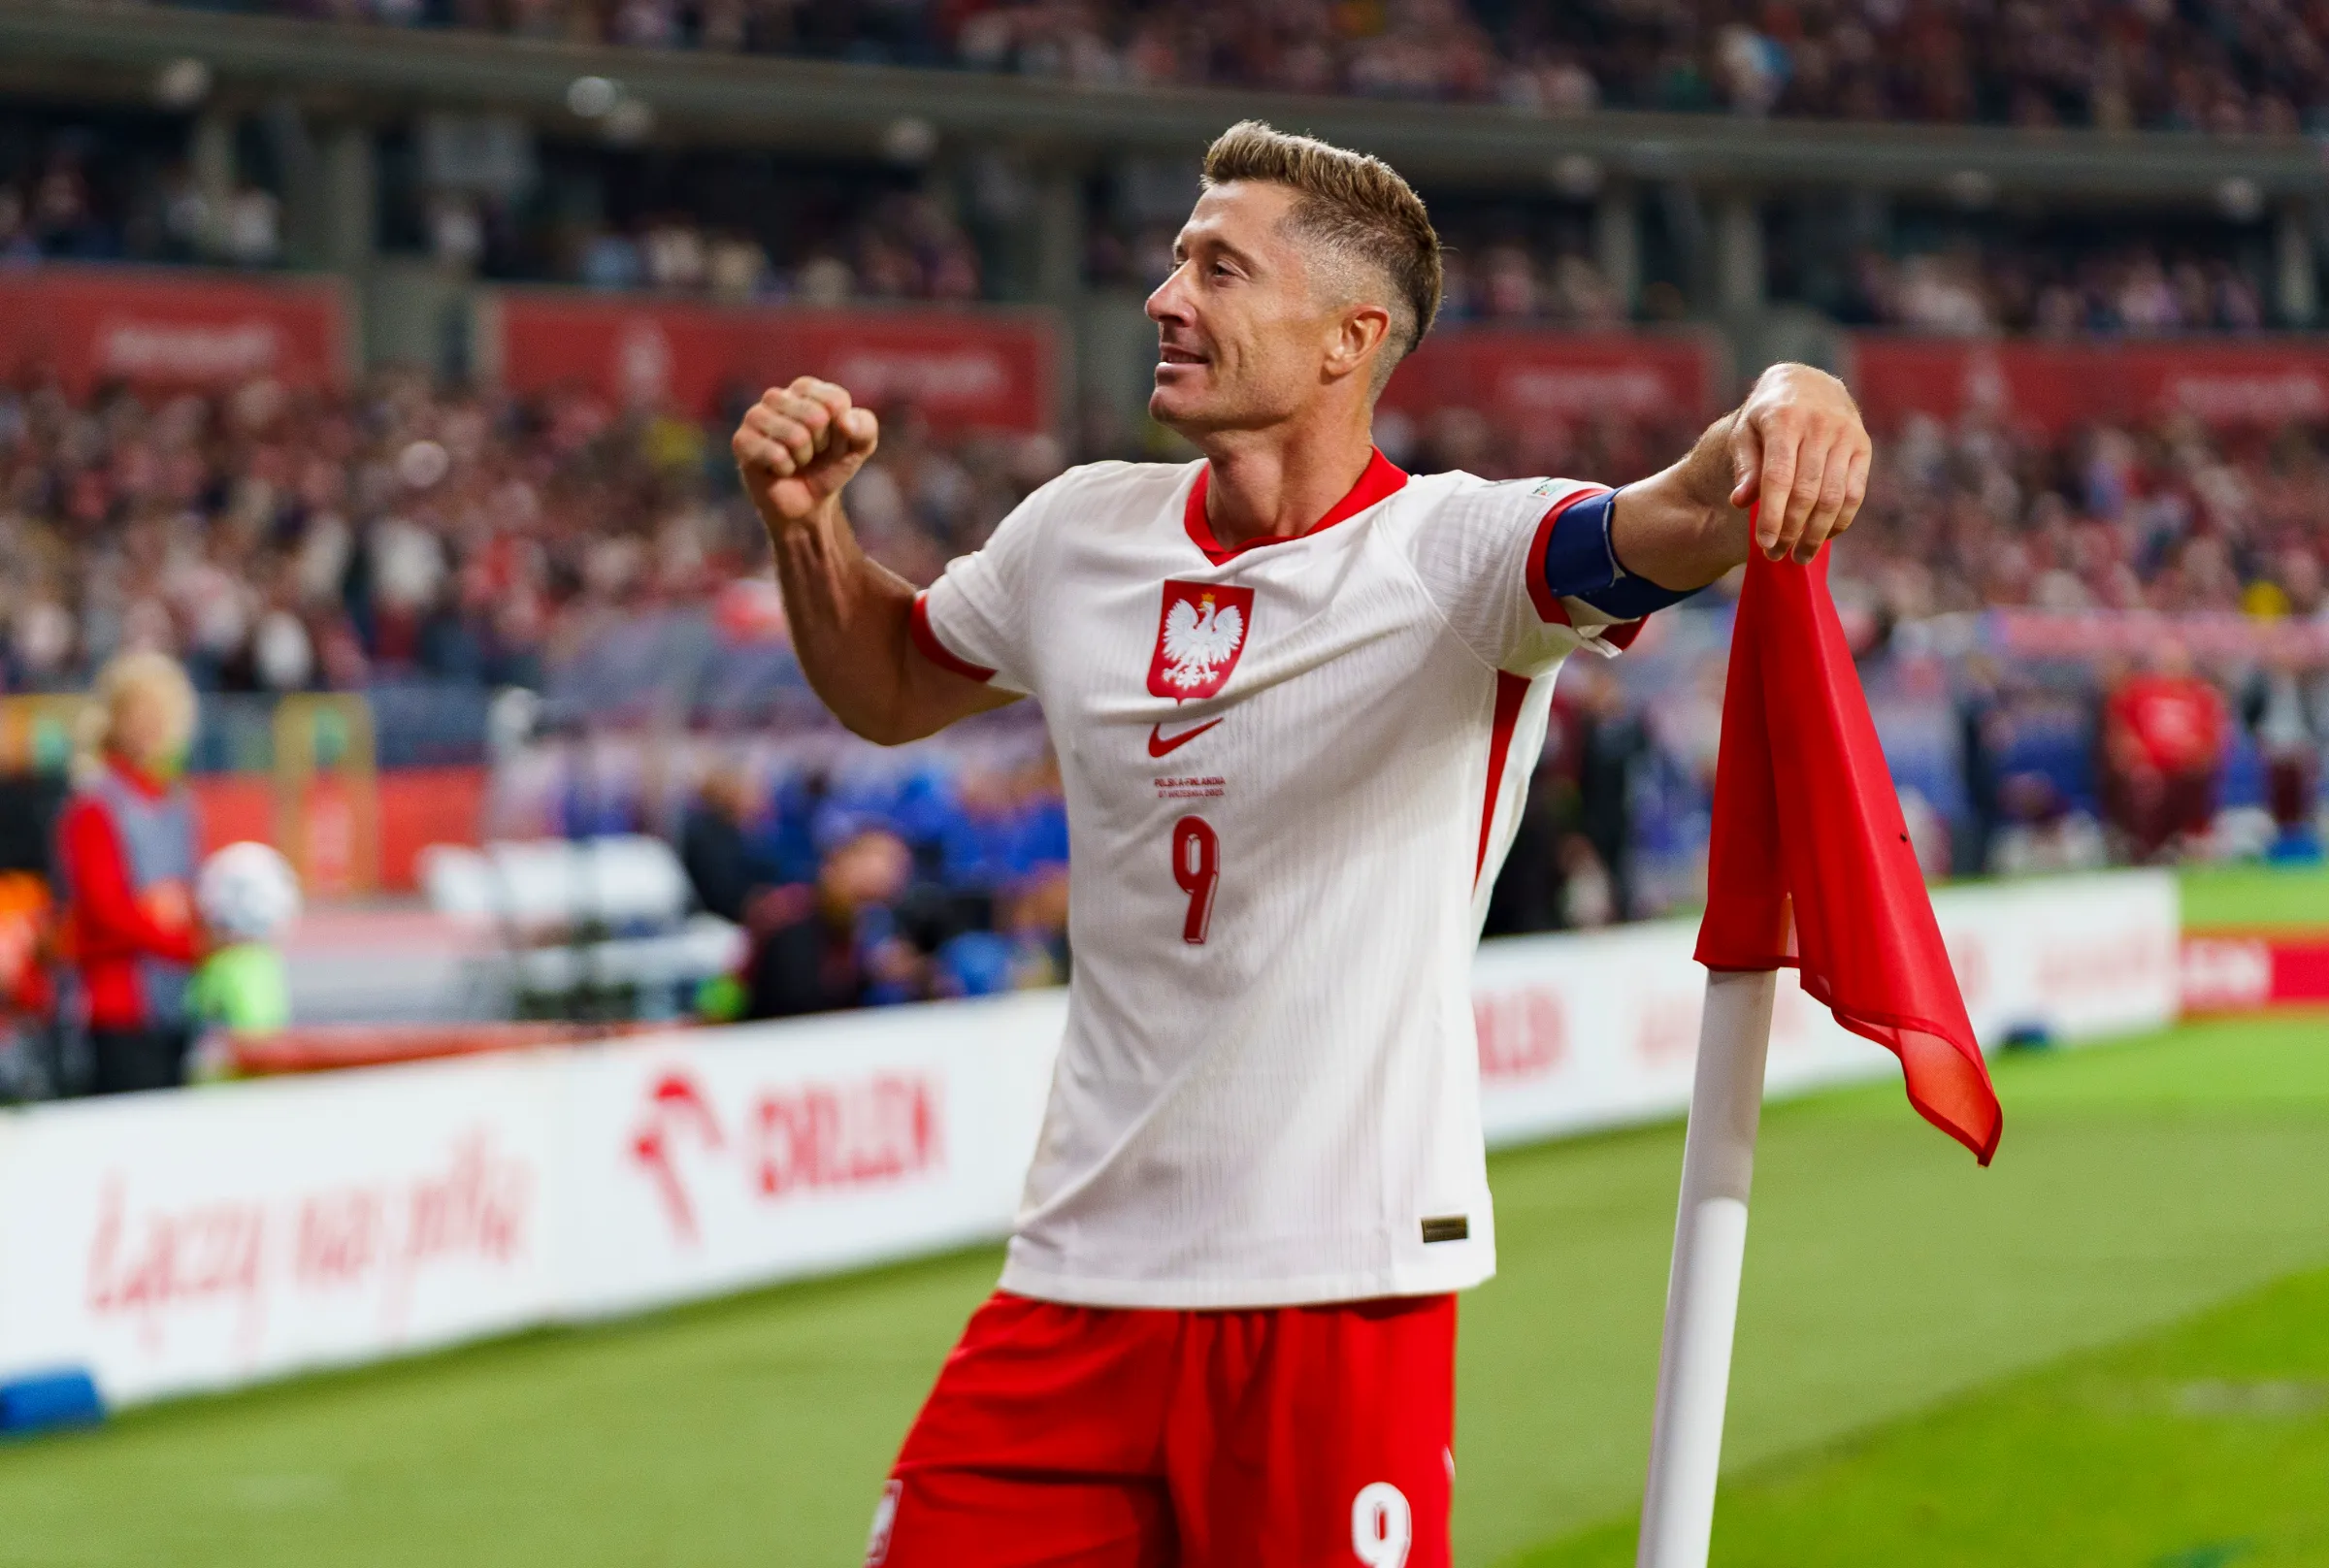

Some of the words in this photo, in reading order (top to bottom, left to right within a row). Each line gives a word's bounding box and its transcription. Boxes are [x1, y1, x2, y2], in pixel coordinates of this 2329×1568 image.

[1172, 815, 1220, 945] 9
[752, 1071, 945, 1197] ORLEN
[1351, 1482, 1412, 1568] 9
